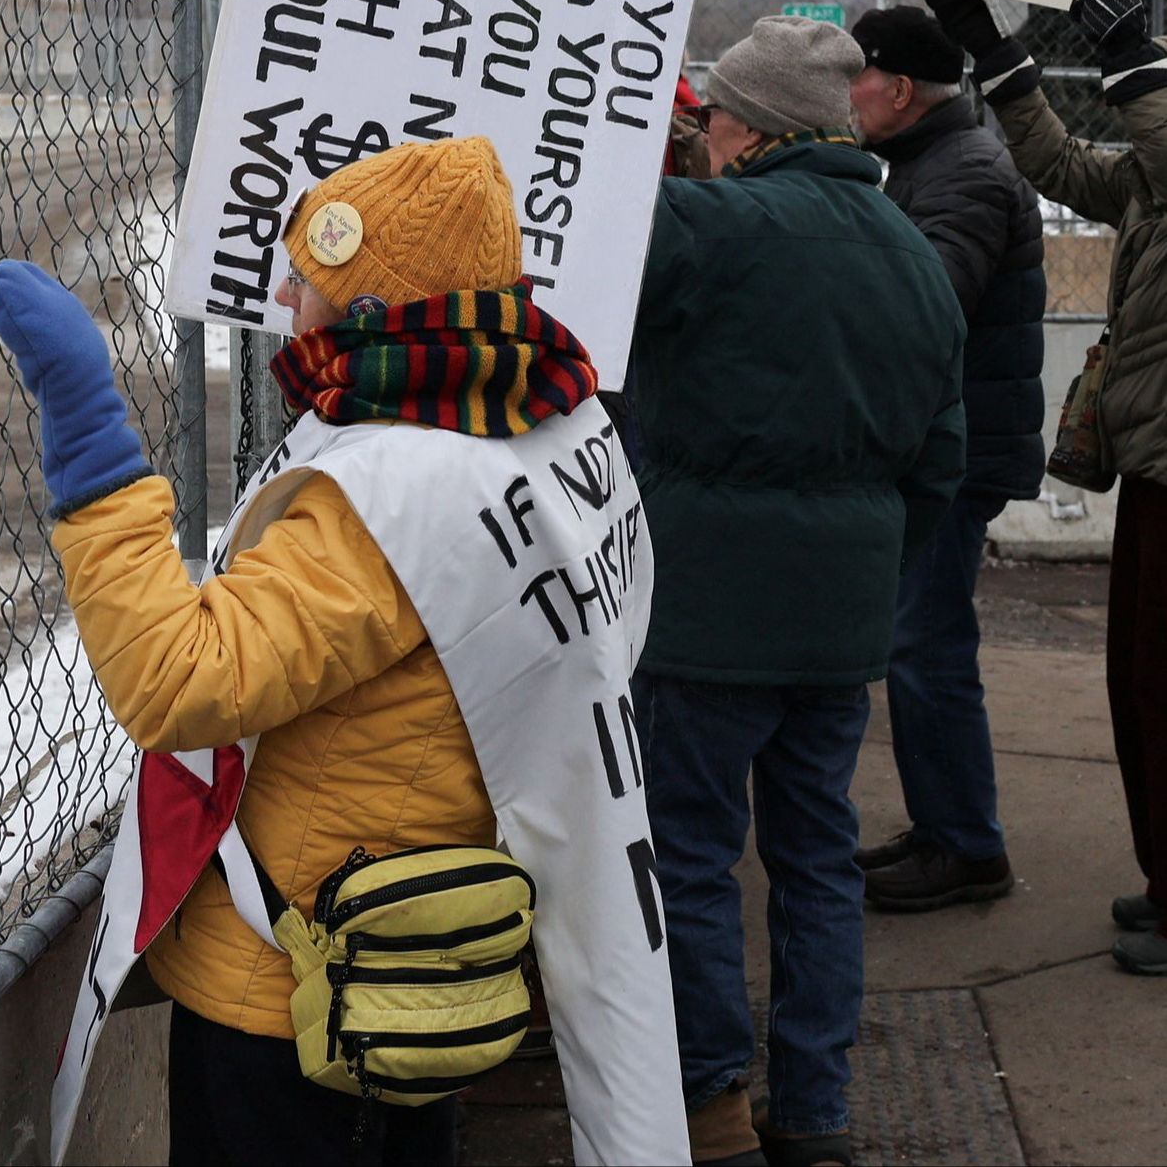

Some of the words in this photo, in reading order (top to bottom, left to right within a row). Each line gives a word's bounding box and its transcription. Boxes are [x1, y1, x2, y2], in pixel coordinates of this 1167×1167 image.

[605, 0, 674, 129] YOU
[206, 97, 304, 325] WORTH
[308, 234, 318, 246] No
[477, 474, 535, 568] IF
